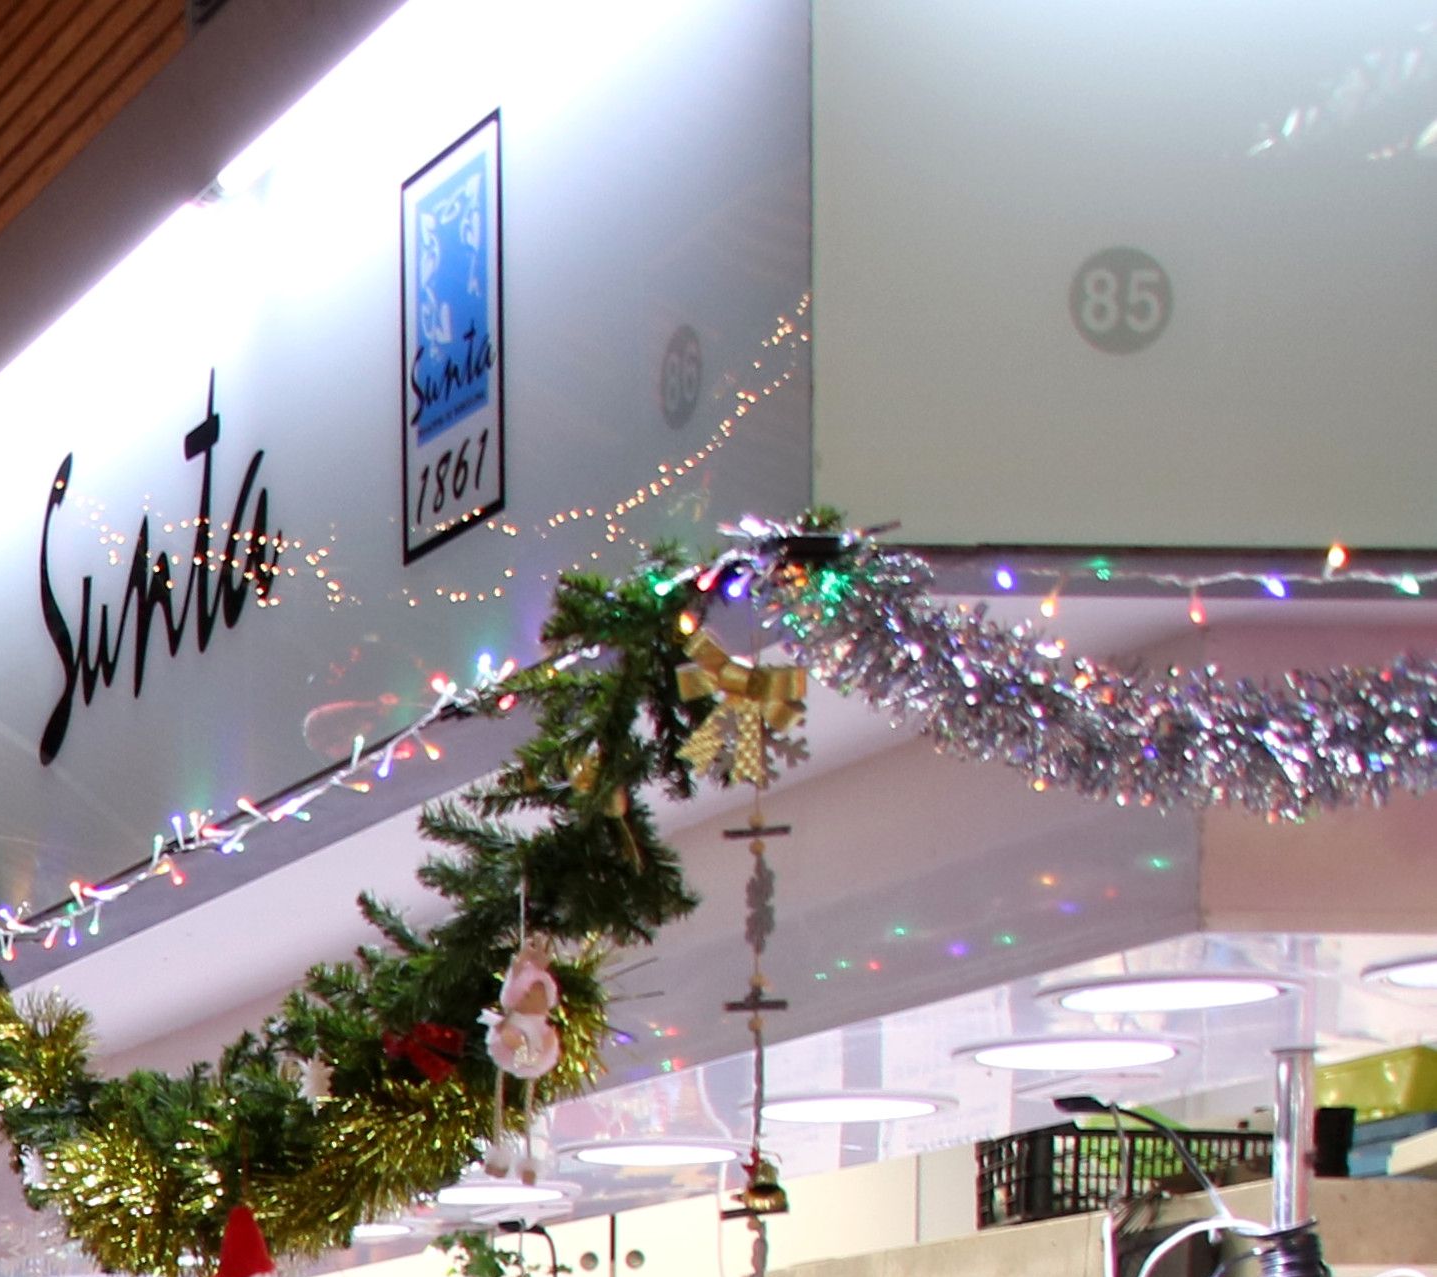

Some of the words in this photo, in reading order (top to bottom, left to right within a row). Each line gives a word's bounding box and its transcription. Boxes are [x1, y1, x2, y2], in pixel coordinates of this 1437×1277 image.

[1085, 270, 1163, 333] 85
[410, 317, 498, 427] Sunta
[416, 429, 489, 525] 1861
[39, 366, 283, 767] Sunta
